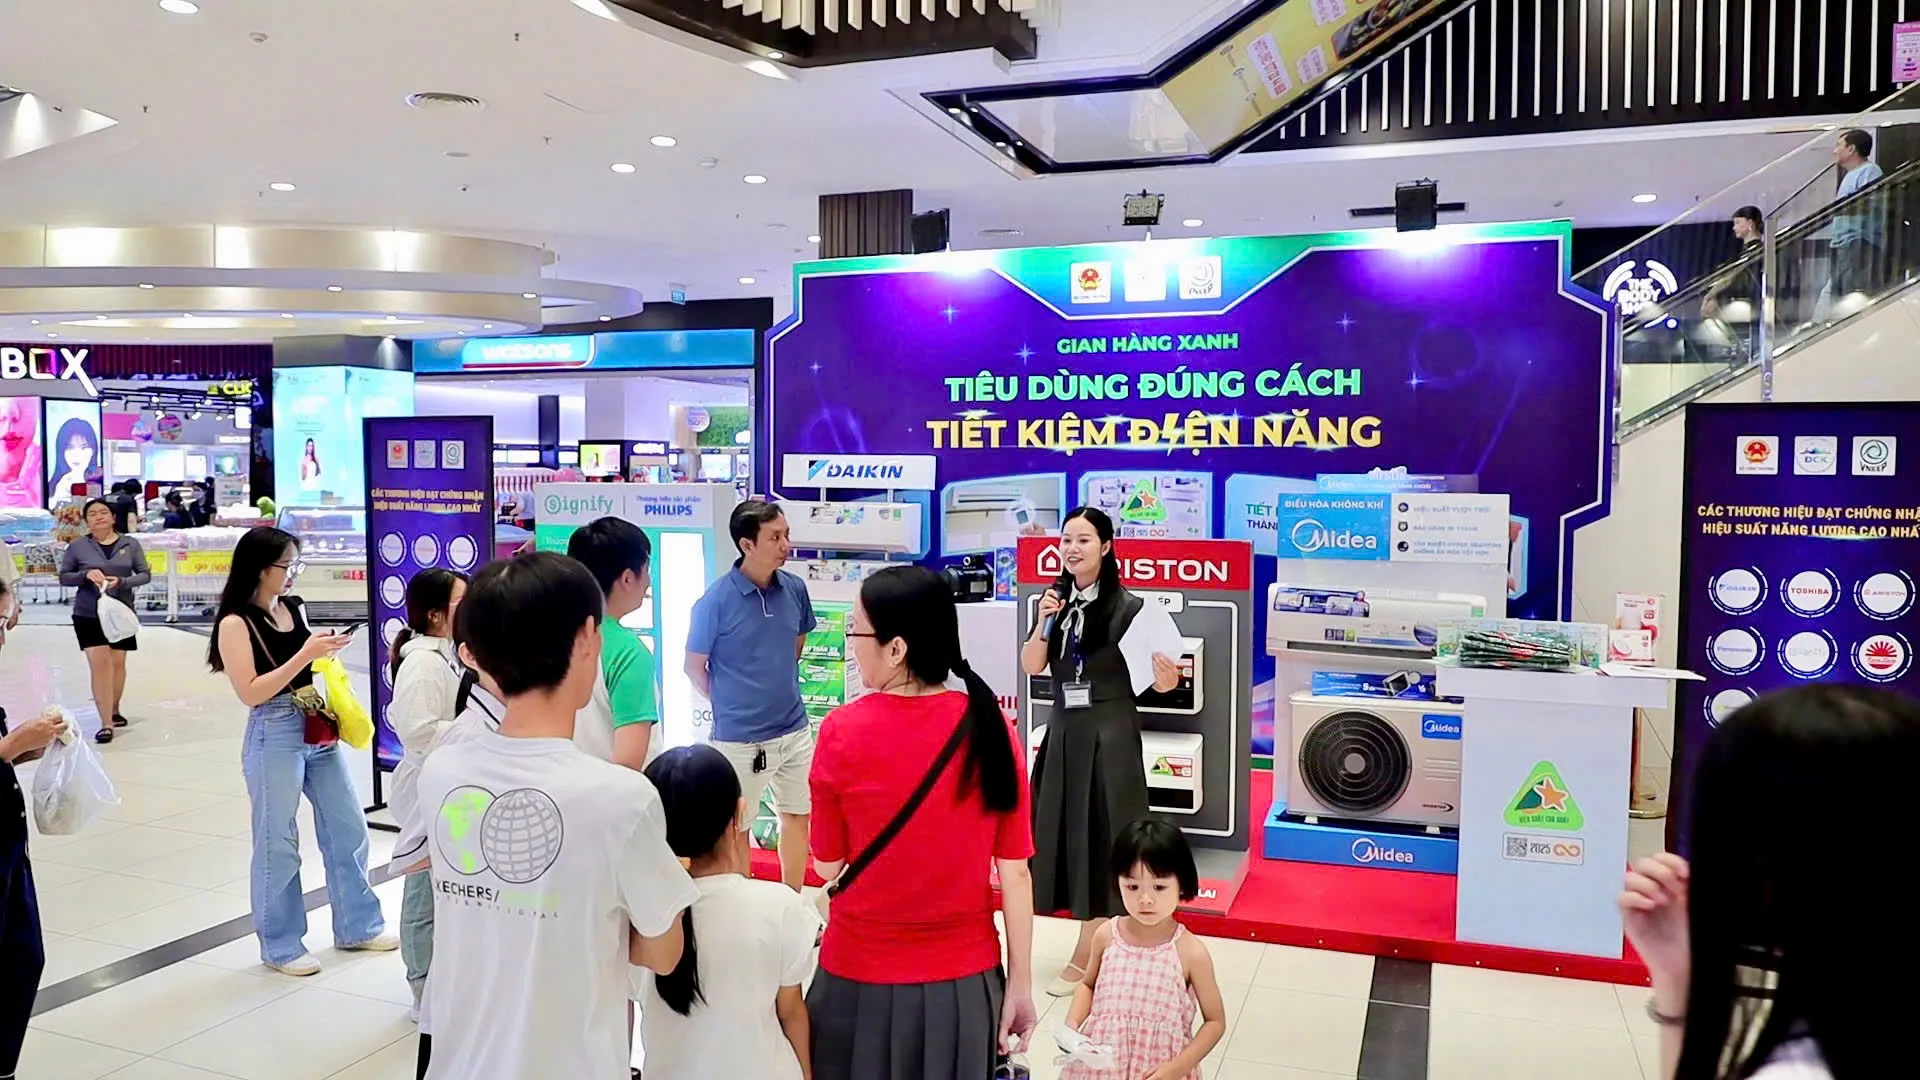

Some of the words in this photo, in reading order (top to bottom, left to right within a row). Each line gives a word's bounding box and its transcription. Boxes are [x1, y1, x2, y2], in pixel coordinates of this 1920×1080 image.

[1618, 288, 1661, 302] BODY
[1057, 337, 1107, 354] GIAN
[1112, 332, 1172, 352] HÀNG
[1177, 333, 1239, 350] XANH
[944, 370, 1019, 402] TIÊU
[1028, 368, 1129, 401] DÙNG
[1137, 365, 1245, 399] ĐÚNG
[1255, 363, 1361, 397] CÁCH
[926, 410, 1008, 449] TIẾT
[1018, 412, 1116, 457] KIỆM
[1254, 408, 1382, 448] NĂNG
[827, 463, 904, 479] DAIKIN
[544, 494, 613, 515] Signify
[645, 504, 693, 516] PHILIPS
[1245, 501, 1273, 517] TIẾT
[1285, 498, 1309, 510] ĐIỀU
[1310, 499, 1330, 510] HÒA
[1331, 499, 1366, 510] KHÔNG
[1368, 498, 1384, 510] KHÍ
[1697, 503, 1725, 518] CÁC
[1727, 505, 1780, 518] THƯƠNG
[1784, 504, 1814, 520] HIỆU
[1817, 507, 1842, 521] ĐẠT
[1845, 504, 1892, 520] CHỨNG
[1895, 506, 1920, 521] NHẬ
[1295, 520, 1377, 552] Midea
[1703, 521, 1732, 537] HIỆU
[1735, 521, 1768, 536] SUẤT
[1771, 522, 1808, 536] NĂNG
[1860, 526, 1887, 538] CAO
[1425, 721, 1460, 733] Midea
[1353, 840, 1414, 863] Midea
[1530, 843, 1551, 855] 2025
[435, 880, 500, 902] KECHERS/
